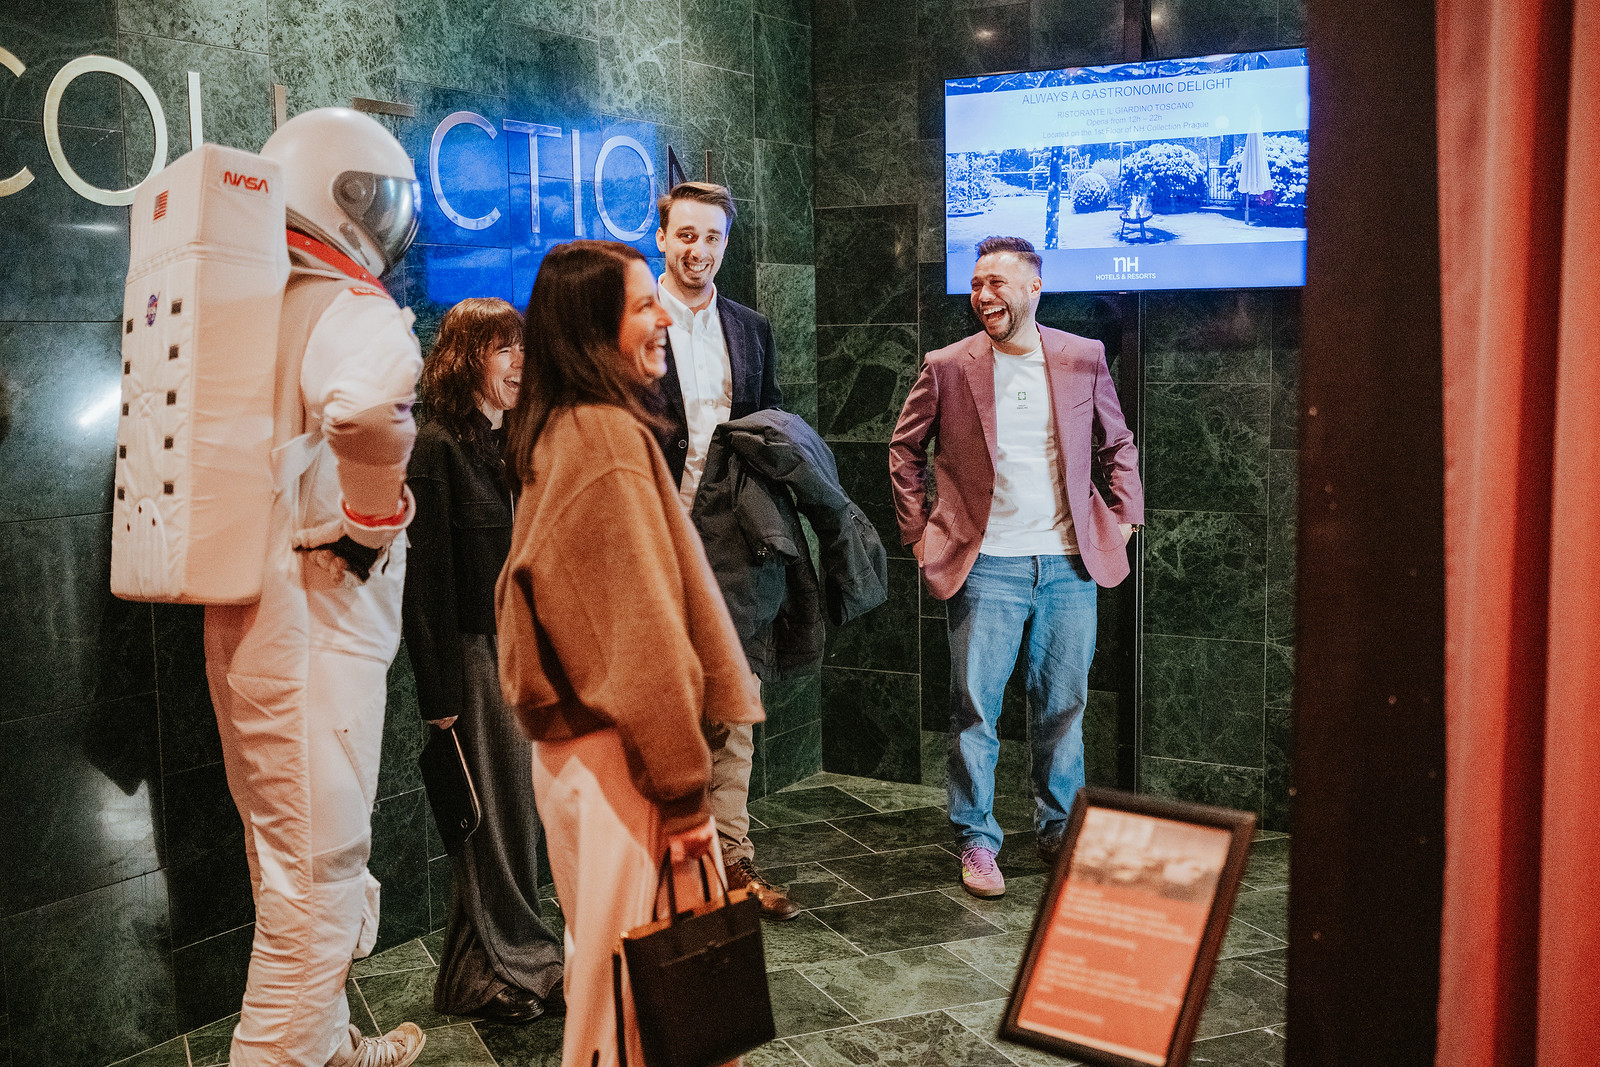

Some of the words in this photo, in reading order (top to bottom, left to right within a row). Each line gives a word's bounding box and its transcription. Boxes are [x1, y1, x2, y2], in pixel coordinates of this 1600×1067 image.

[1022, 90, 1068, 104] ALWAYS
[1071, 90, 1079, 101] A
[1082, 82, 1174, 100] GASTRONOMIC
[1177, 77, 1233, 92] DELIGHT
[1057, 108, 1105, 118] RISTORANTE
[1107, 107, 1113, 115] IL
[1115, 104, 1153, 114] GIARDINO
[1155, 101, 1194, 111] TOSCANO
[1086, 118, 1109, 127] Opens
[1110, 116, 1126, 124] from
[1128, 115, 1141, 123] 12h
[1149, 114, 1163, 122] 22h
[1042, 130, 1069, 139] Located
[1081, 128, 1091, 136] the
[1094, 128, 1104, 136] 1st
[1105, 127, 1123, 135] Floor
[1146, 122, 1181, 132] Collection
[1183, 121, 1209, 130] Prague
[223, 171, 269, 194] NASA
[1127, 272, 1157, 280] RESORTS
